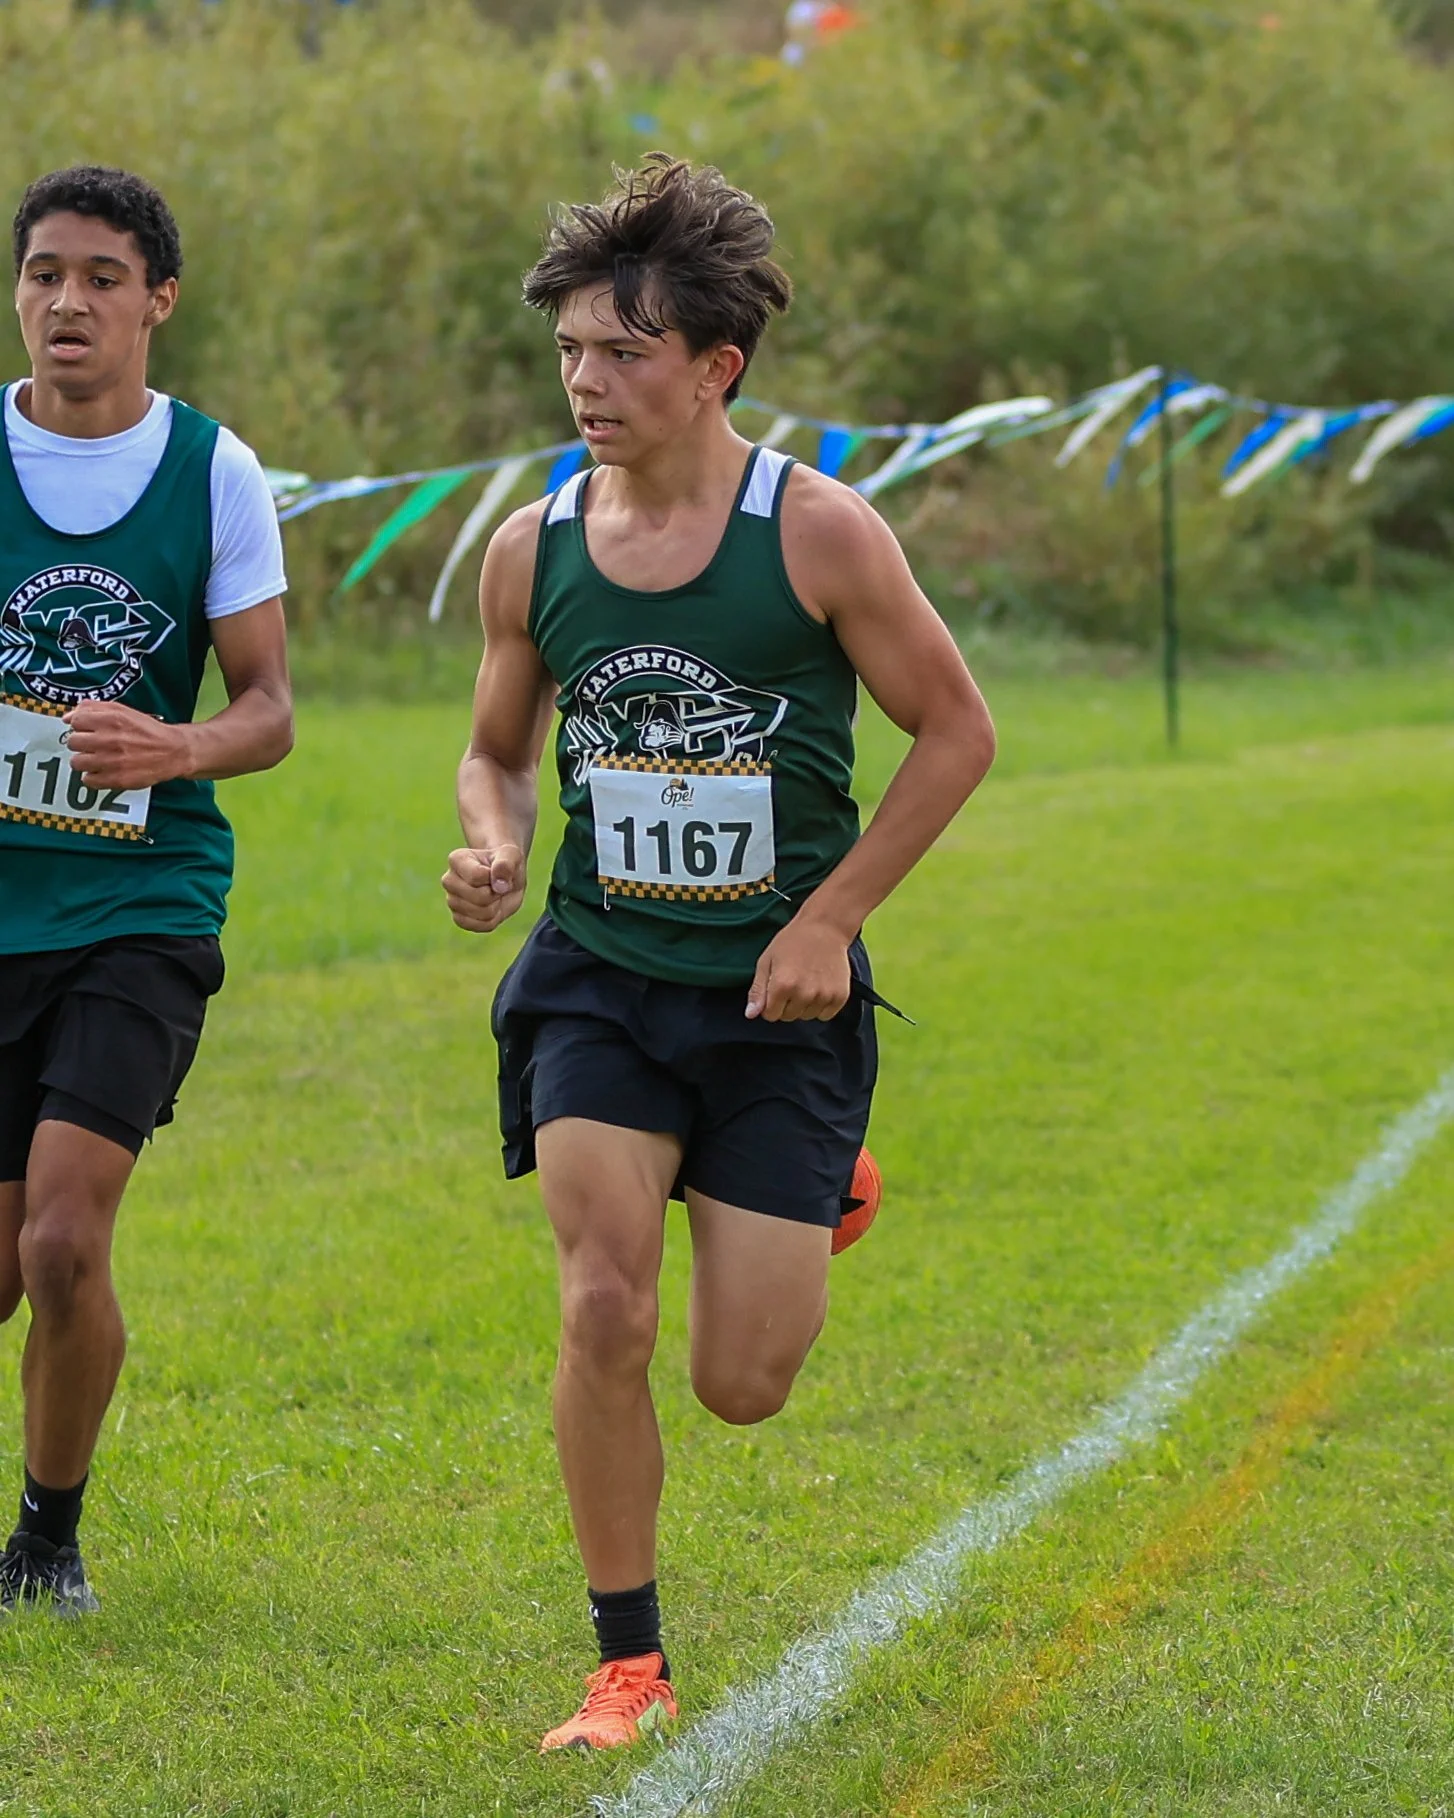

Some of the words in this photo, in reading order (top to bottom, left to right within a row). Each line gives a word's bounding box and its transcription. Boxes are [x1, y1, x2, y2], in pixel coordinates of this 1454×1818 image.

[9, 568, 130, 613] WATERFORD
[30, 656, 139, 704] KETTERING
[661, 786, 694, 808] Ope!
[613, 816, 753, 877] 1167
